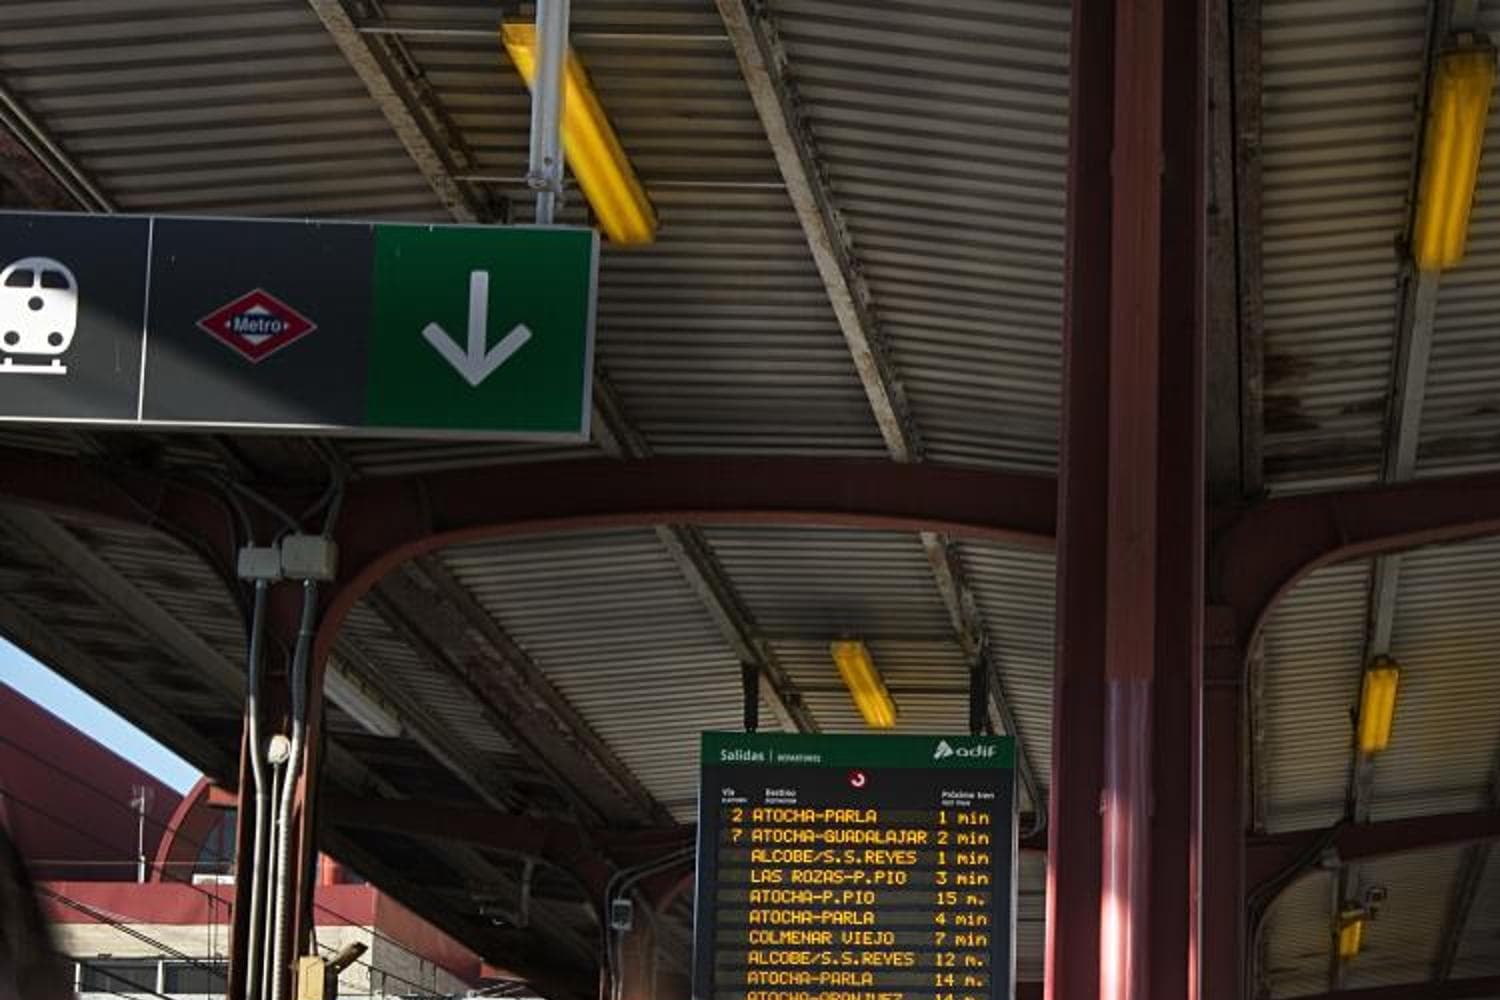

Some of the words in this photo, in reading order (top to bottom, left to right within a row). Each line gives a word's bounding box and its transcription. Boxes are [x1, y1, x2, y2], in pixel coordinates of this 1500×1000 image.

[233, 317, 281, 332] Metro
[721, 749, 764, 761] Salidas
[956, 745, 997, 757] adif
[732, 808, 743, 822] 2
[752, 808, 877, 823] ATOCHA-PARLA
[939, 810, 946, 825] 1
[957, 810, 990, 825] min
[731, 828, 743, 842] 7
[752, 829, 928, 844] ATOCHA-GUADALAJAR
[937, 831, 949, 846] 2
[957, 831, 990, 846] min
[751, 850, 917, 865] ALCOBE/S.S.REYES
[938, 851, 946, 865] 1
[957, 851, 990, 866] min
[751, 869, 783, 883] LAS
[792, 869, 907, 885] ROZAS-P.PIO
[935, 871, 948, 886] 3
[956, 871, 990, 886] min
[750, 890, 875, 905] ATOCHA-P.PIO
[937, 891, 958, 905] 15
[749, 910, 875, 925] ATOCHA-PARLA
[935, 912, 946, 926] 4
[955, 912, 988, 927] min
[749, 931, 833, 945] COLMENAR
[841, 931, 895, 945] VIEJO
[934, 931, 946, 946] 7
[955, 931, 988, 947] min
[748, 951, 915, 967] ALCOBE/S.S.REYES
[935, 951, 956, 967] 12
[747, 971, 874, 987] ATOCHA-PARLA
[935, 972, 955, 987] 14
